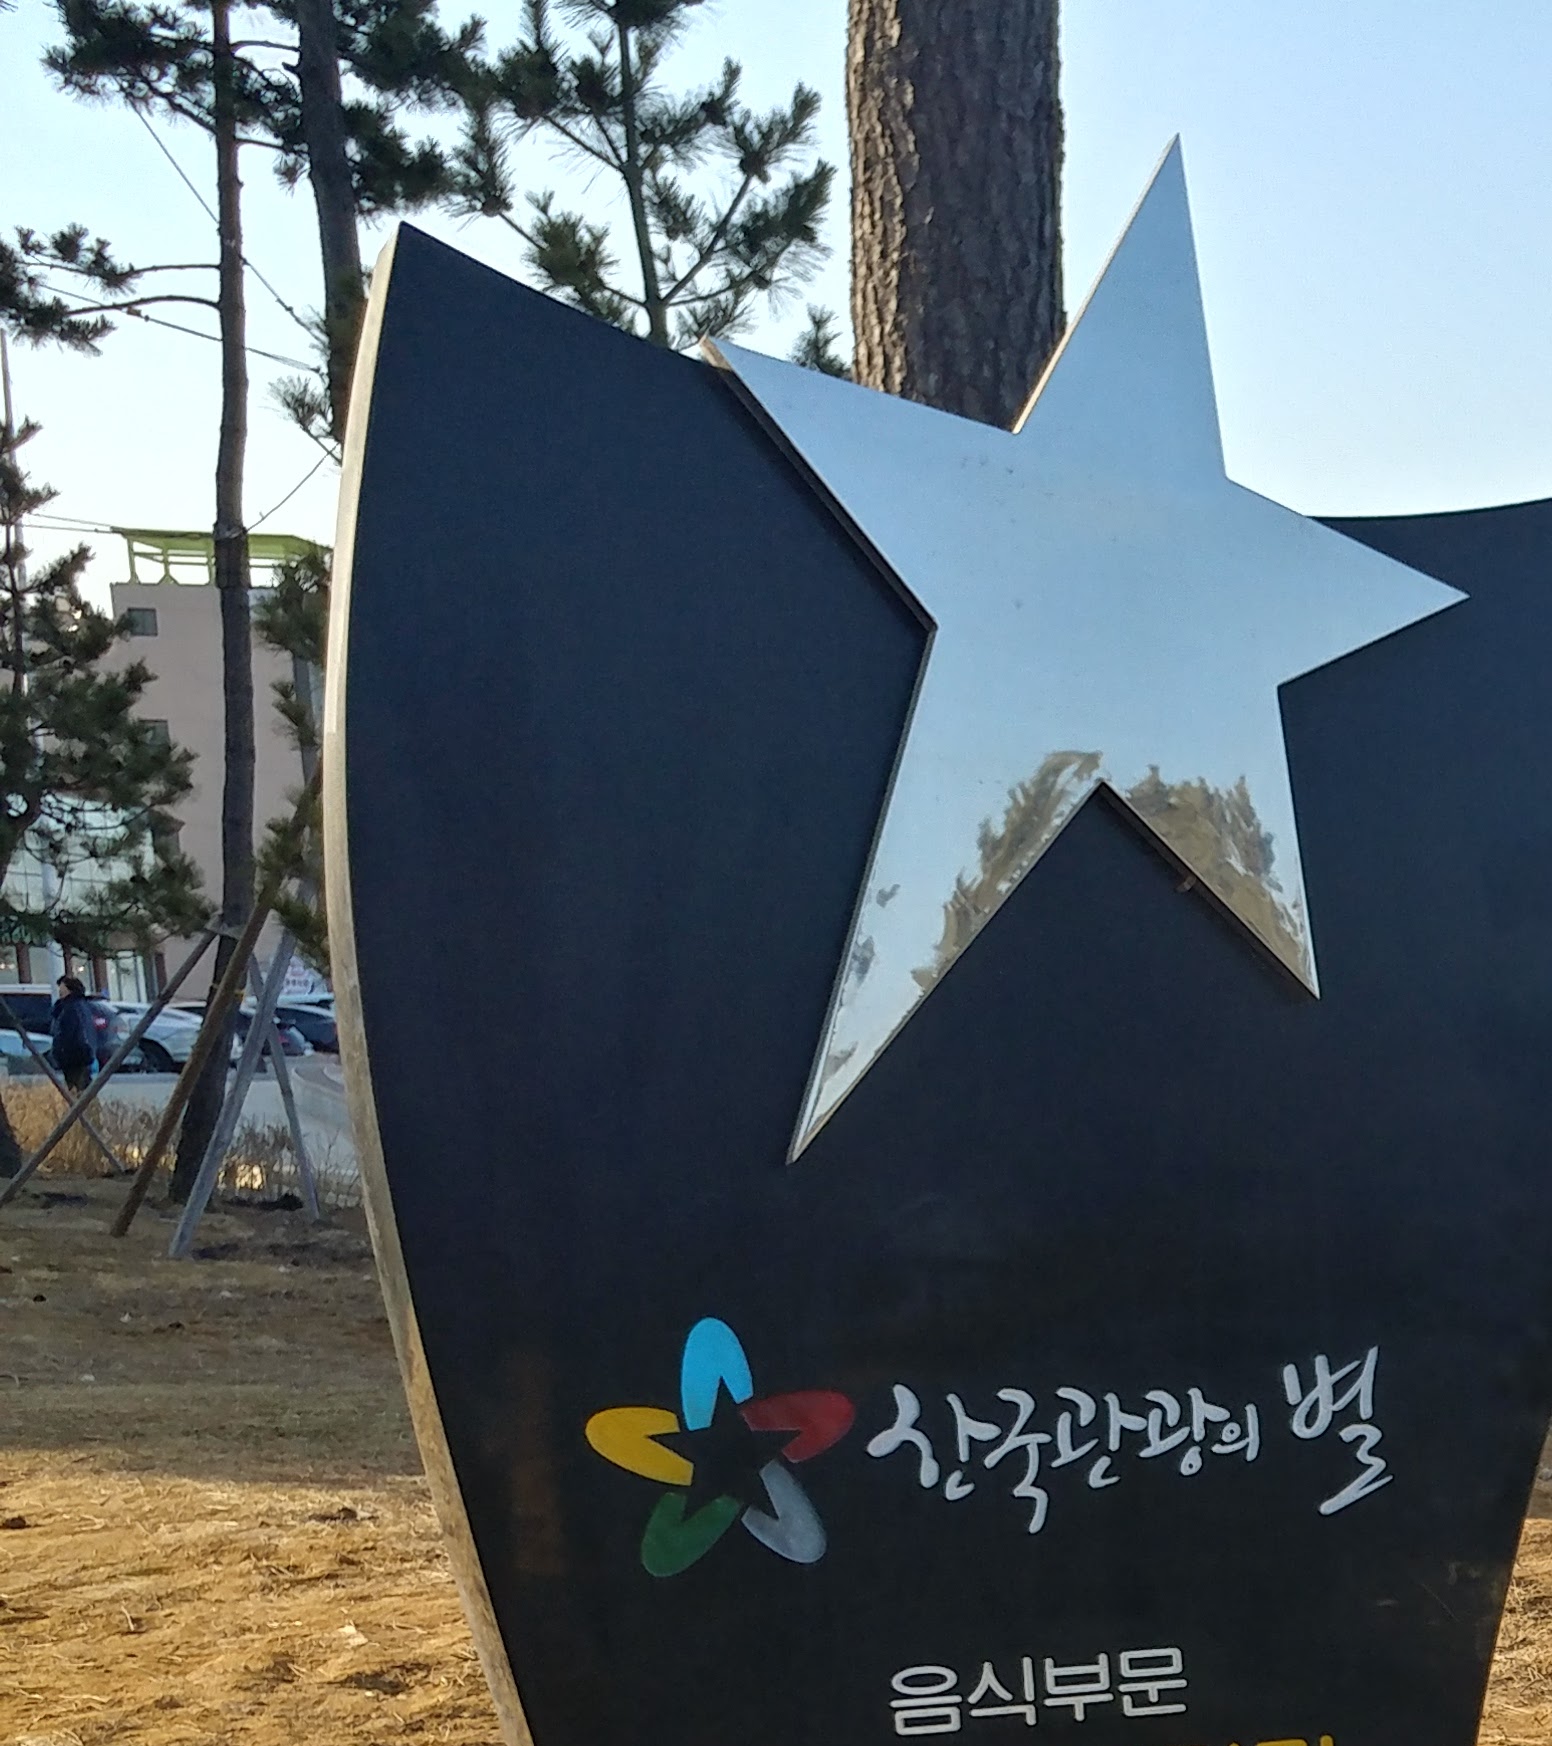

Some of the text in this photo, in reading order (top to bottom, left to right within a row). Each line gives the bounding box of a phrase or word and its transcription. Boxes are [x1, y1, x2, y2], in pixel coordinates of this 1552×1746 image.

[866, 1346, 1394, 1534] 한국관광의 별
[890, 1647, 1188, 1736] 음식부문
